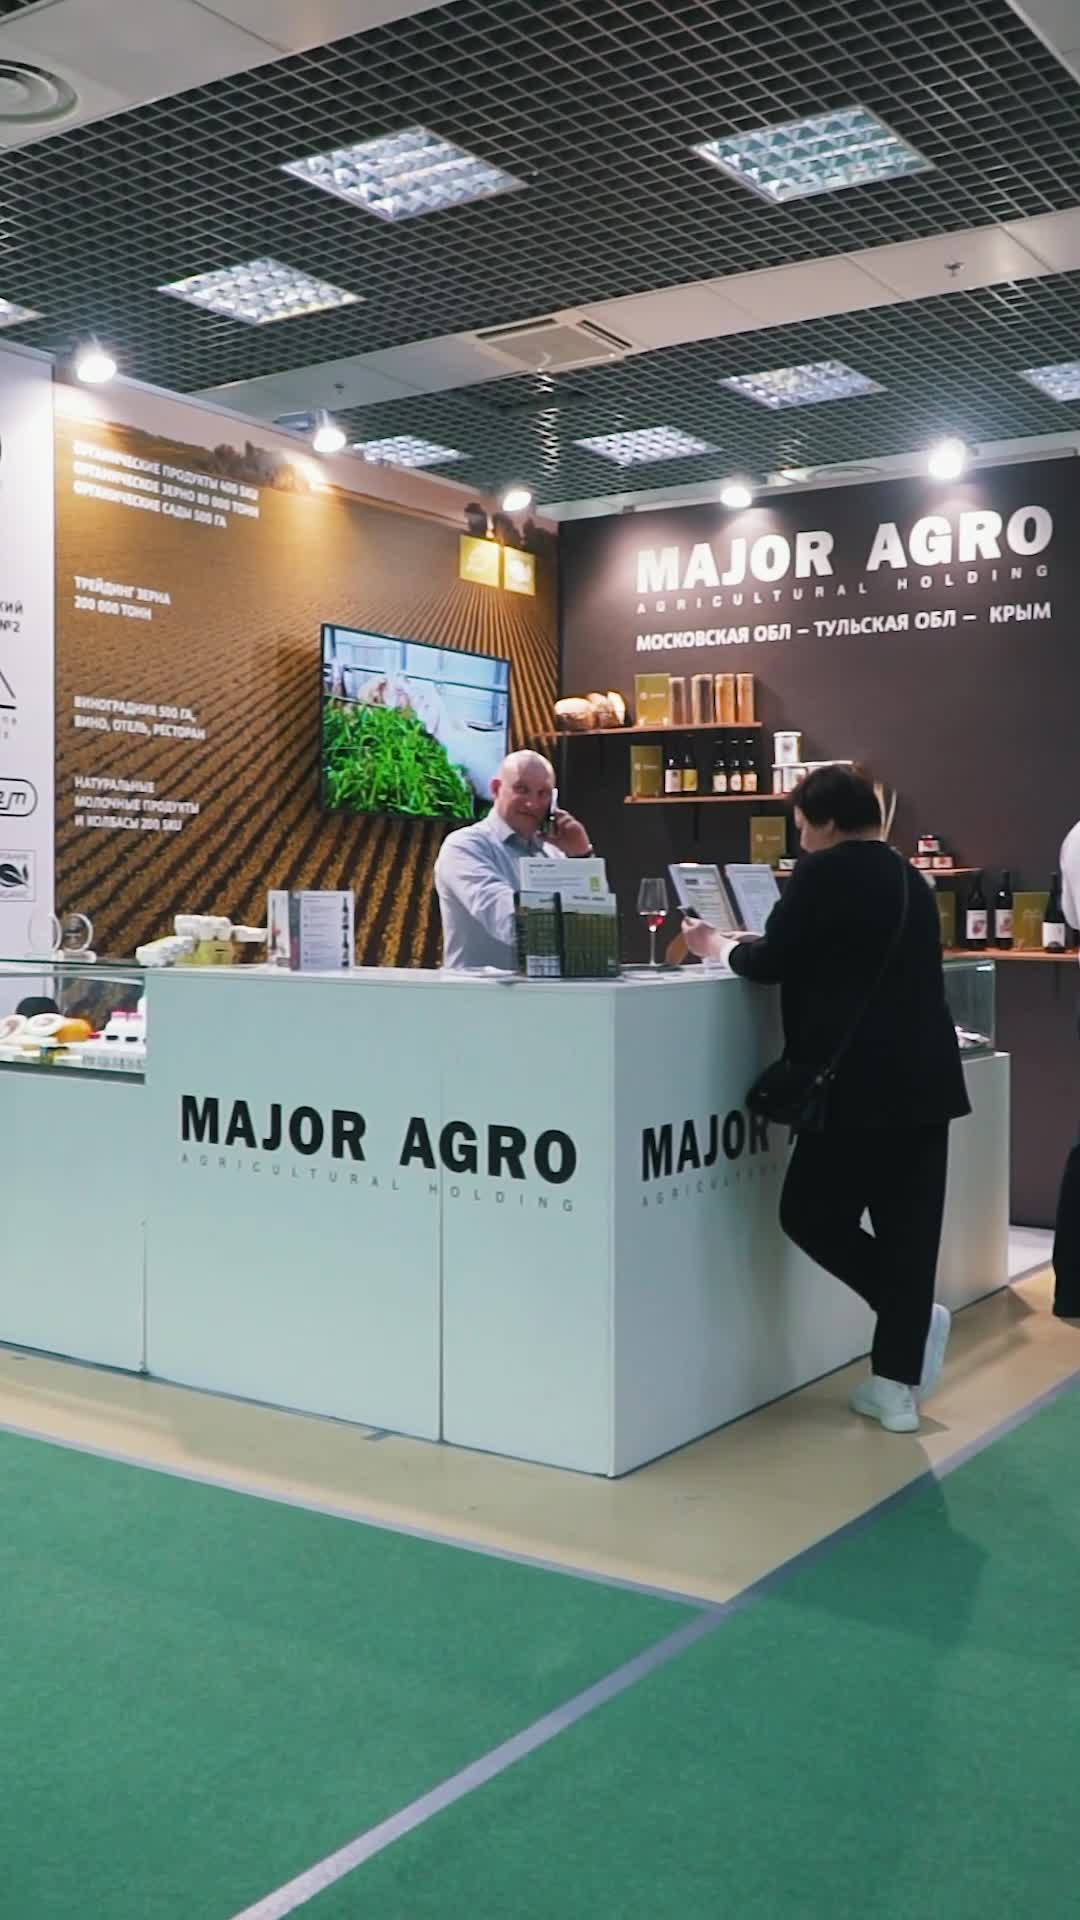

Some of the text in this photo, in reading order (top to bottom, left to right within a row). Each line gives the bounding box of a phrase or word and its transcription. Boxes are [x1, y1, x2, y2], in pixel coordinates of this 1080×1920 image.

[161, 482, 195, 501] ЗЕРНО
[162, 502, 193, 519] САДЫ
[214, 514, 228, 528] ГА
[636, 505, 1053, 593] MAJOR AGRO
[73, 575, 135, 598] ТРЕЙДИНГ
[637, 565, 1048, 614] AGRICULTURAL HOLDING
[120, 602, 152, 620] ТОНН
[636, 627, 749, 651] МОСКОВСКАЯ
[754, 623, 791, 642] ОБЛ
[813, 613, 909, 637] ТУЛЬСКАЯ
[914, 609, 956, 630] ОБЛ
[989, 602, 1051, 623] КРЫМ
[153, 723, 206, 739] РЕСТОРАН
[74, 776, 155, 793] НАТУРАЛЬНЫЕ
[74, 795, 200, 814] МОЛОЧНЫЕ ПРОДУКТЫ
[74, 814, 84, 827] И
[86, 815, 139, 829] КОЛБАСЫ
[181, 1095, 577, 1184] MAJOR AGRO
[642, 1109, 770, 1182] MAJOR
[181, 1153, 573, 1211] AGRICULTURAL HOLDING
